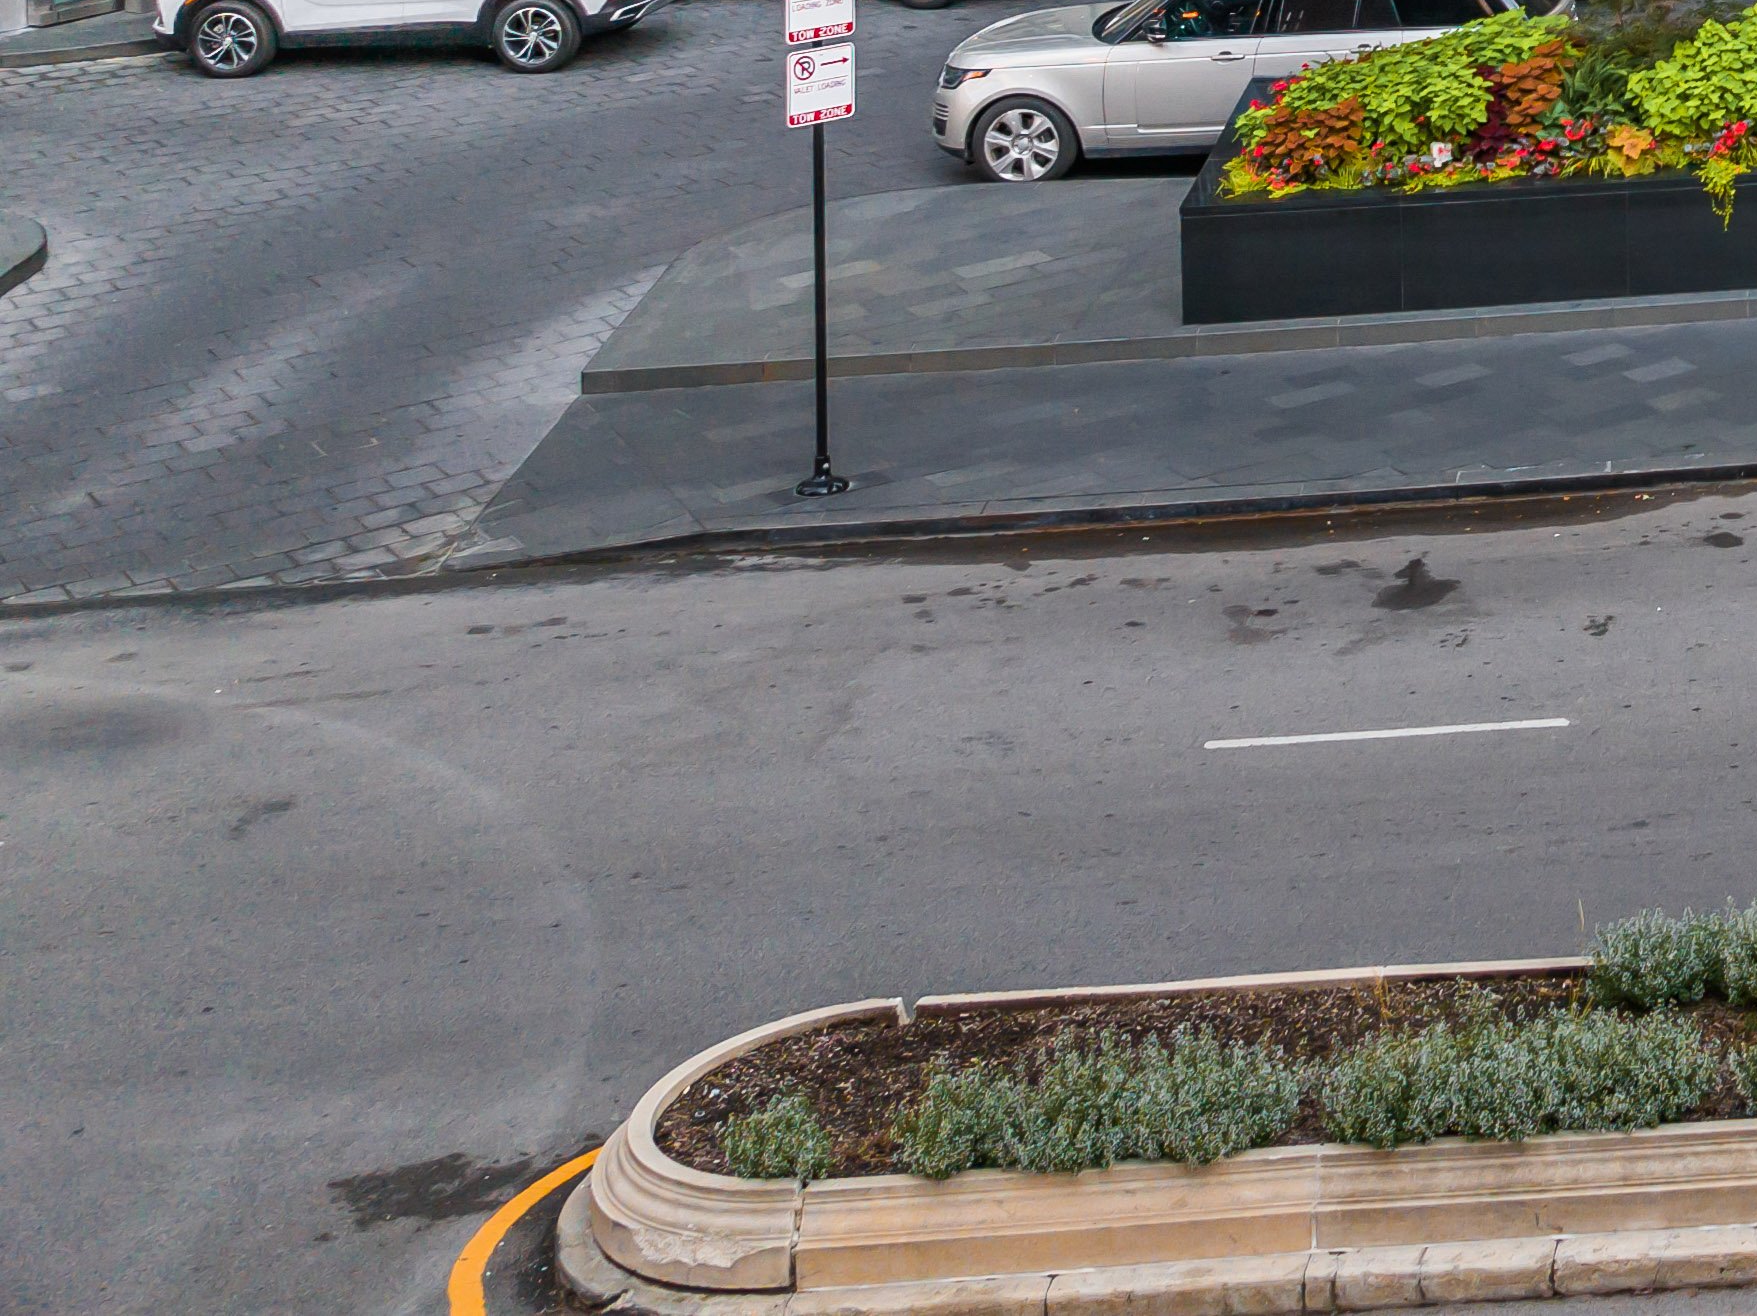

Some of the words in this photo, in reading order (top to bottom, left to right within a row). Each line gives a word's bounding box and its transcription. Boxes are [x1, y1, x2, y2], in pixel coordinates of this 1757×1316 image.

[792, 29, 815, 41] TOW
[819, 23, 848, 37] ZONE
[792, 112, 815, 125] TOW
[820, 105, 848, 119] ZONE
